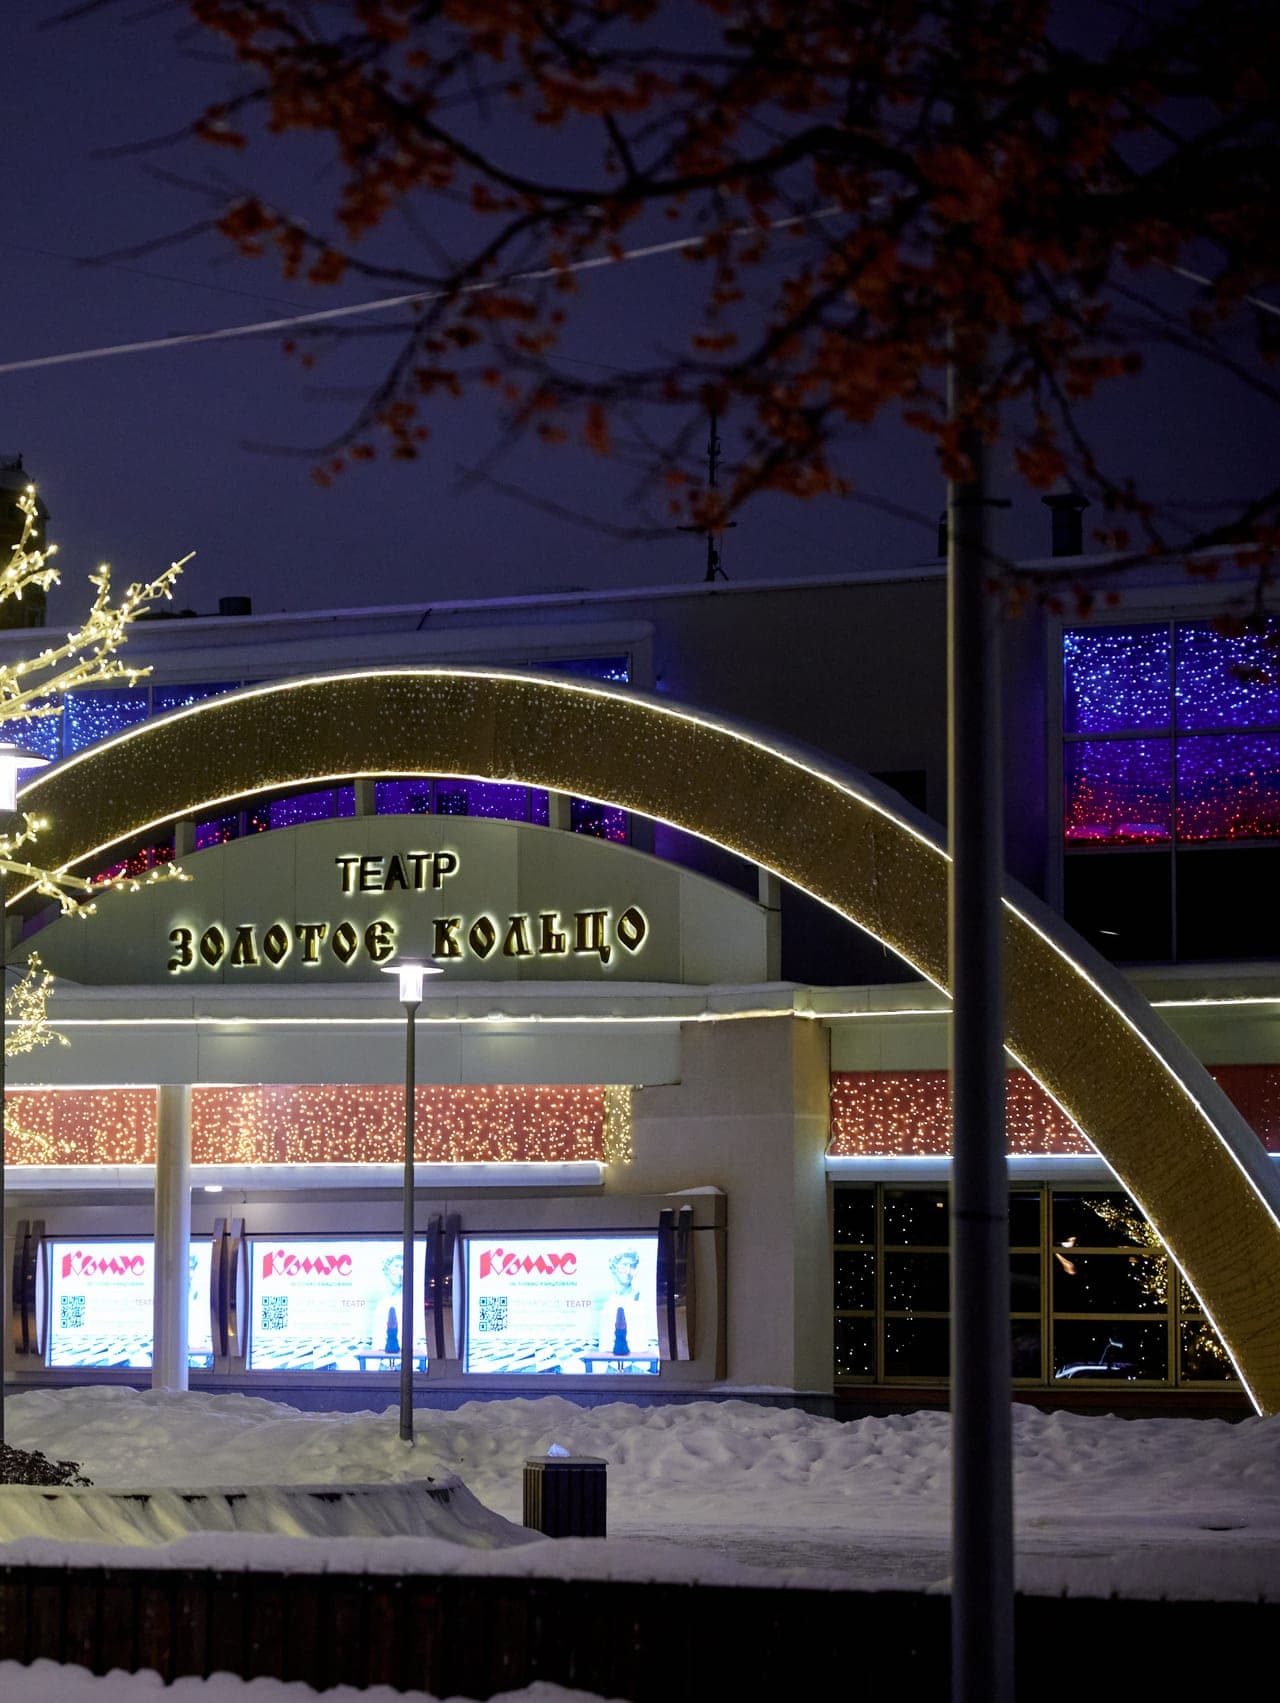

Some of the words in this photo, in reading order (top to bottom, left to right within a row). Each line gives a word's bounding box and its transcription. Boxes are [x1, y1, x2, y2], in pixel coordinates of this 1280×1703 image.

[335, 852, 458, 893] ТЕАТР
[432, 905, 646, 964] КОЛЬЦО
[341, 1299, 366, 1308] ТЕАТР
[566, 1299, 592, 1308] ТЕАТР
